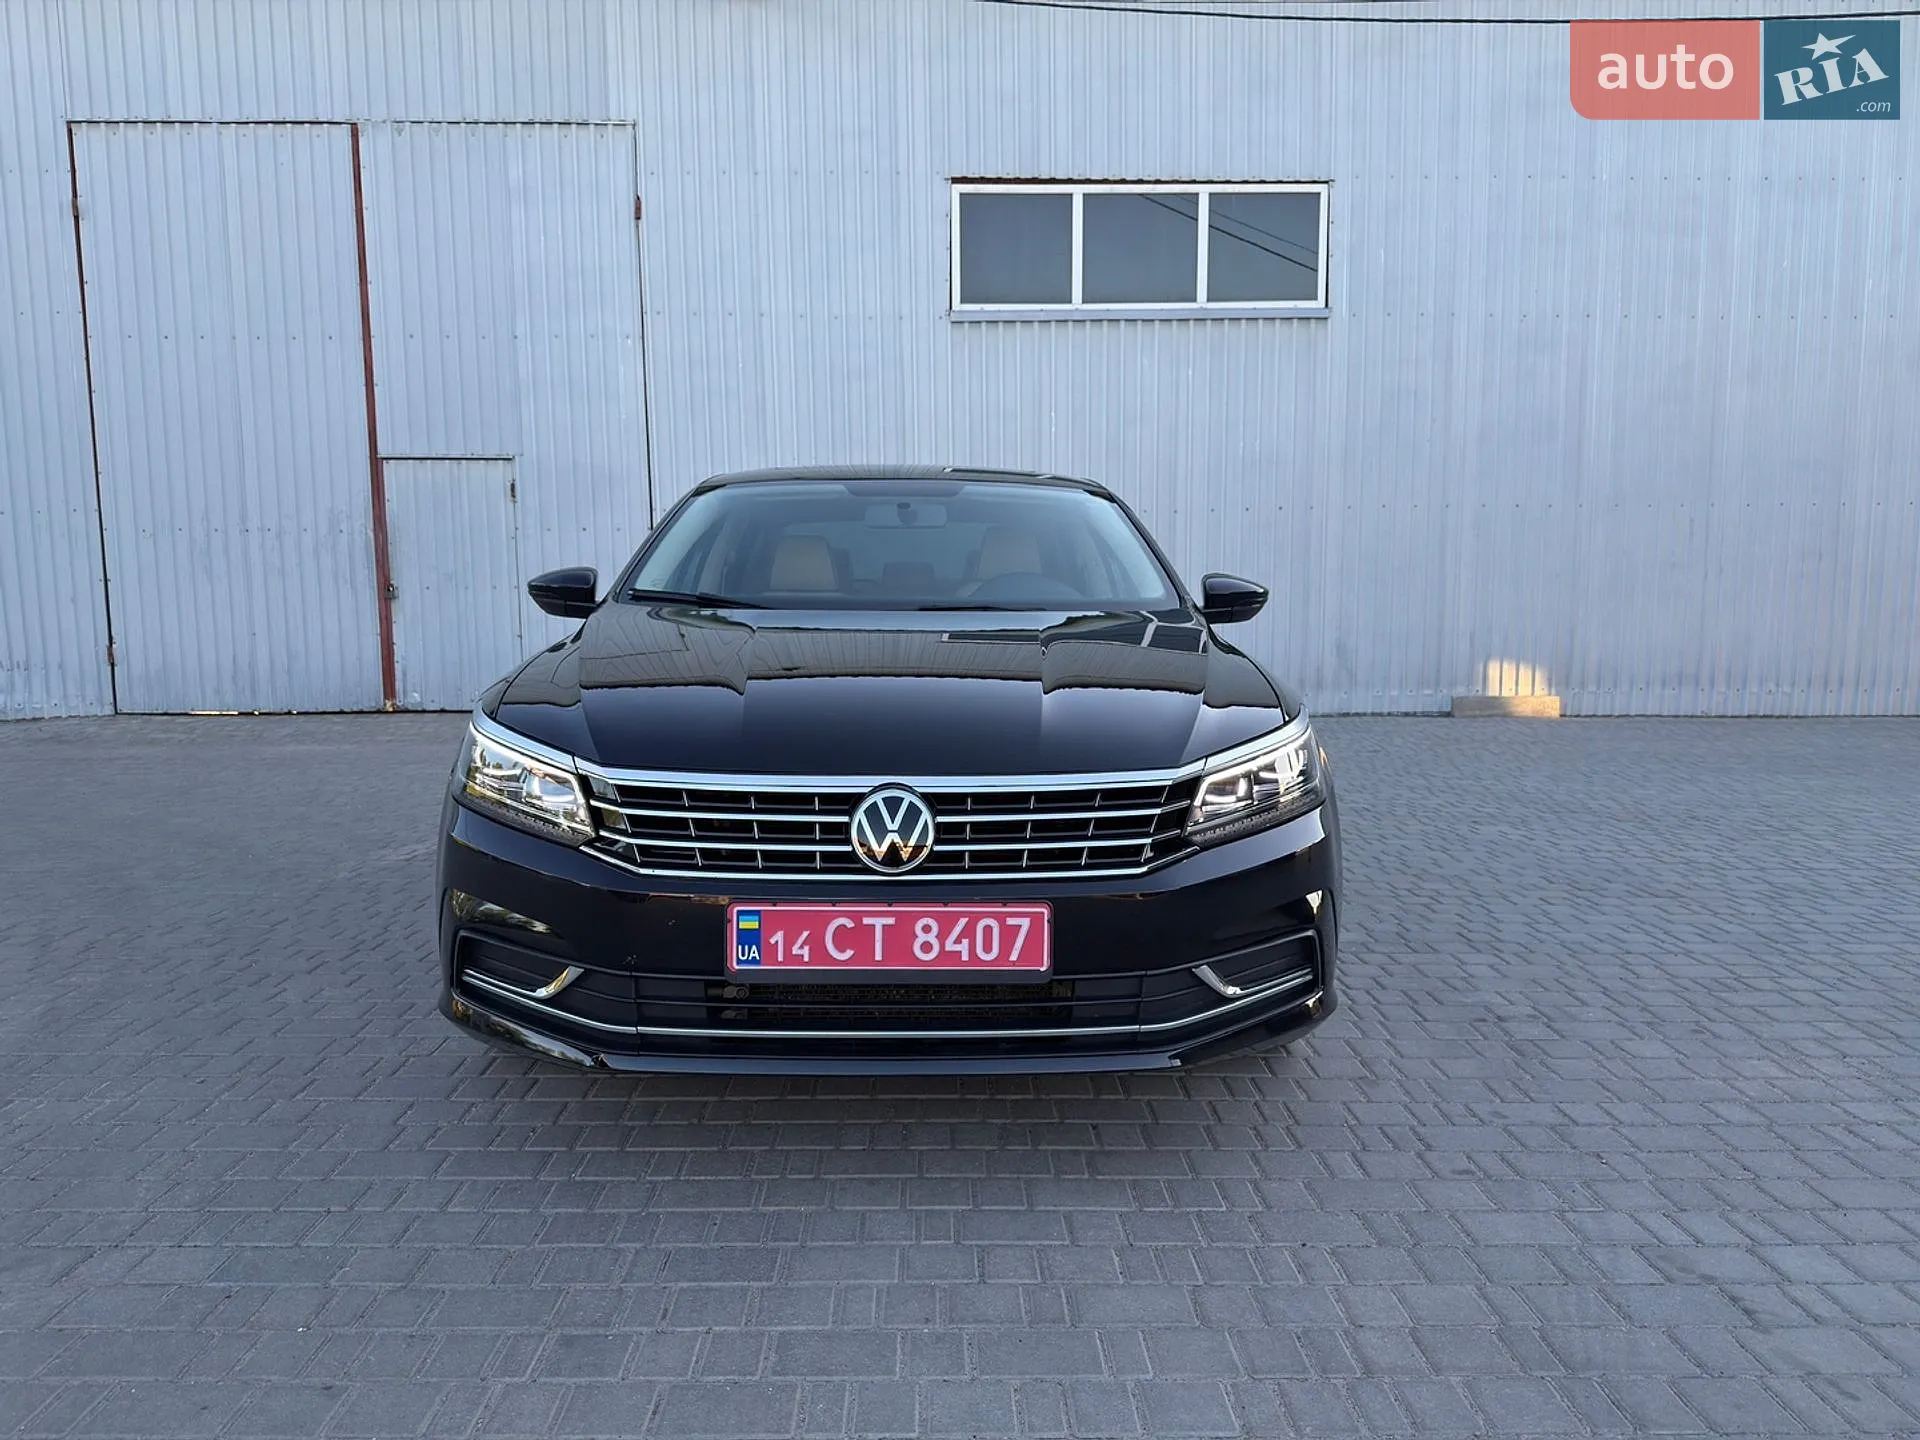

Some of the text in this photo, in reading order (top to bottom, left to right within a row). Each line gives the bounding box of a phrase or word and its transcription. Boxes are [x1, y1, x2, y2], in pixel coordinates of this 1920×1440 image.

[738, 944, 760, 961] UA
[768, 916, 1032, 962] 14 CT 8407
